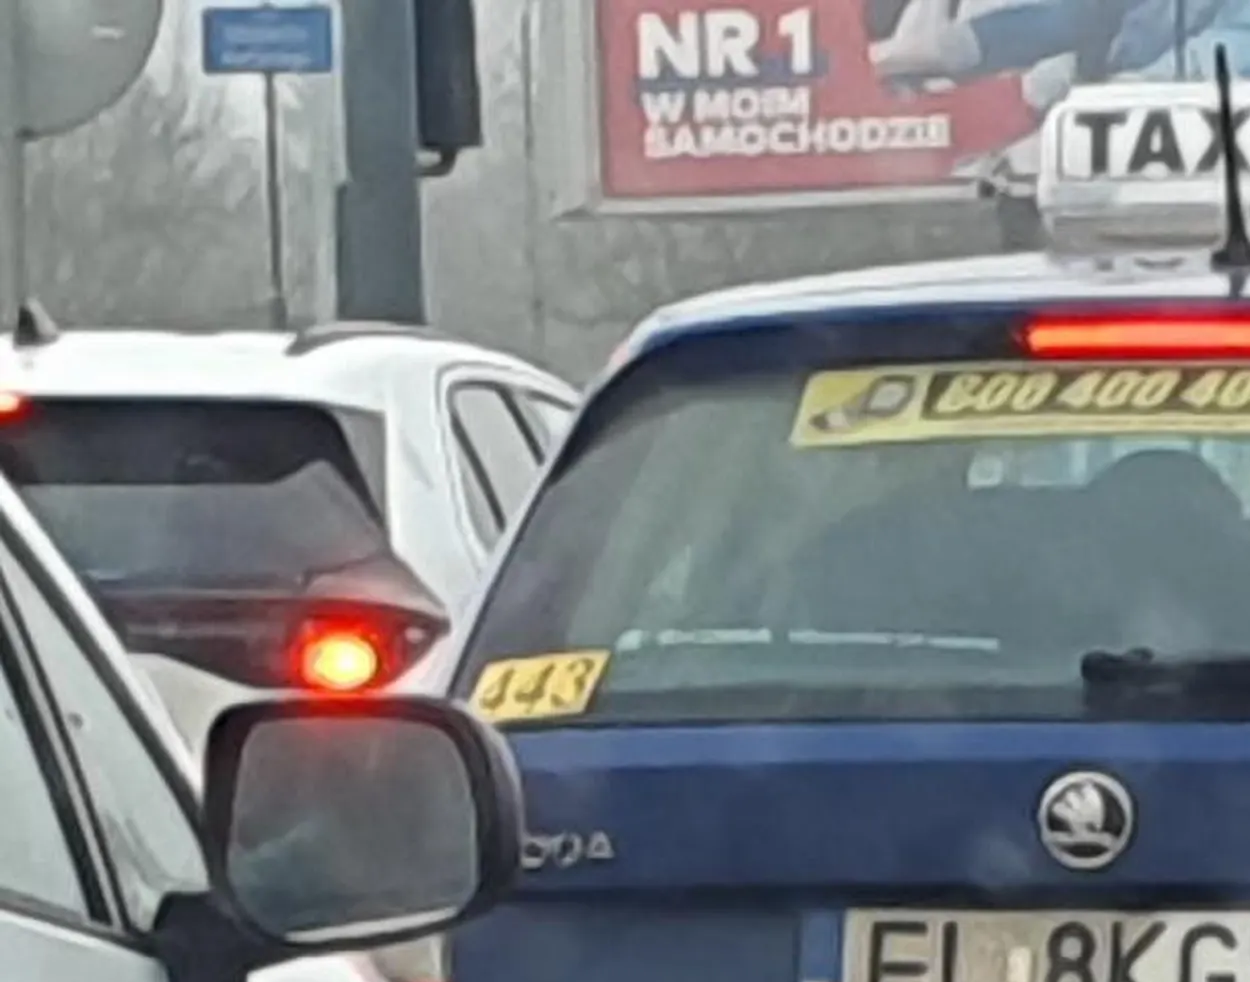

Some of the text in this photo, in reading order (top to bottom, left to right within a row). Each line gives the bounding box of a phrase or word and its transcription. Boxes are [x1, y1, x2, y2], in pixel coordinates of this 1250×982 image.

[637, 10, 811, 79] NR 1
[641, 86, 810, 123] W MOIM
[644, 114, 950, 159] SAMOCHODZIE
[933, 370, 1058, 414] 800
[1058, 369, 1182, 410] 400
[480, 657, 595, 714] 443
[520, 830, 616, 869] ODA
